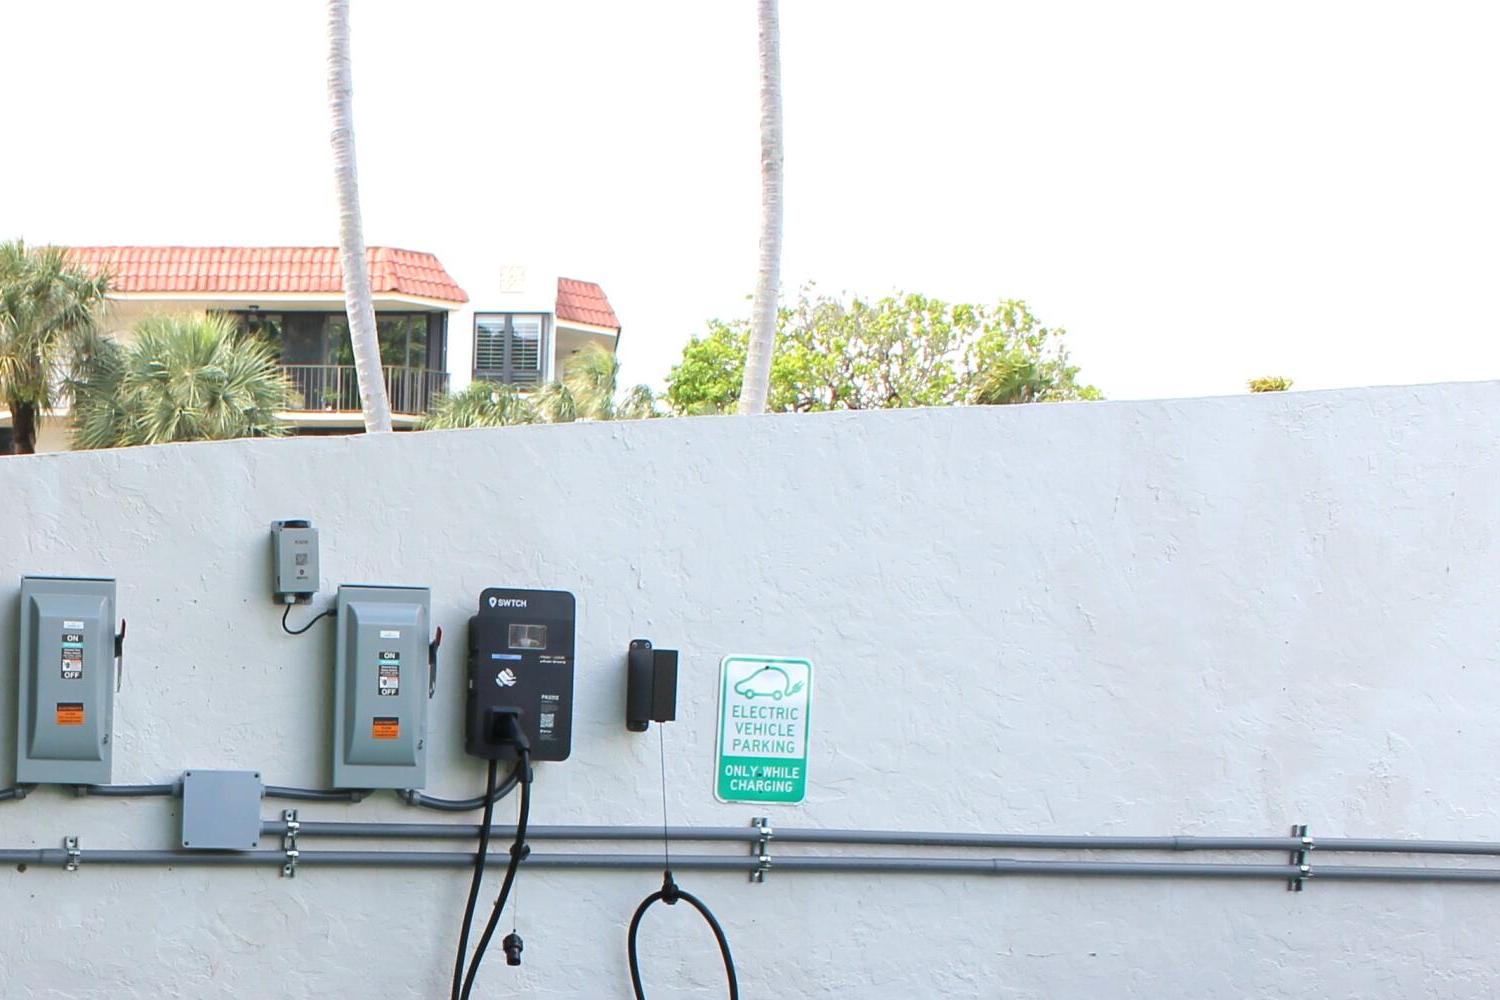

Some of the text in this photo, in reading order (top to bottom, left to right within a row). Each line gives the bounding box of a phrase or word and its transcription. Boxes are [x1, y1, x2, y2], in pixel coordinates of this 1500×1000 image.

[497, 598, 527, 608] SWTCH
[66, 634, 79, 642] ON
[64, 671, 80, 679] OFF
[381, 688, 397, 696] OFF
[732, 704, 799, 720] ELECTRIC
[735, 722, 795, 737] VEHICLE
[732, 739, 795, 754] PARKING
[725, 764, 800, 779] ONLY WHILE
[730, 779, 793, 793] CHARGING
